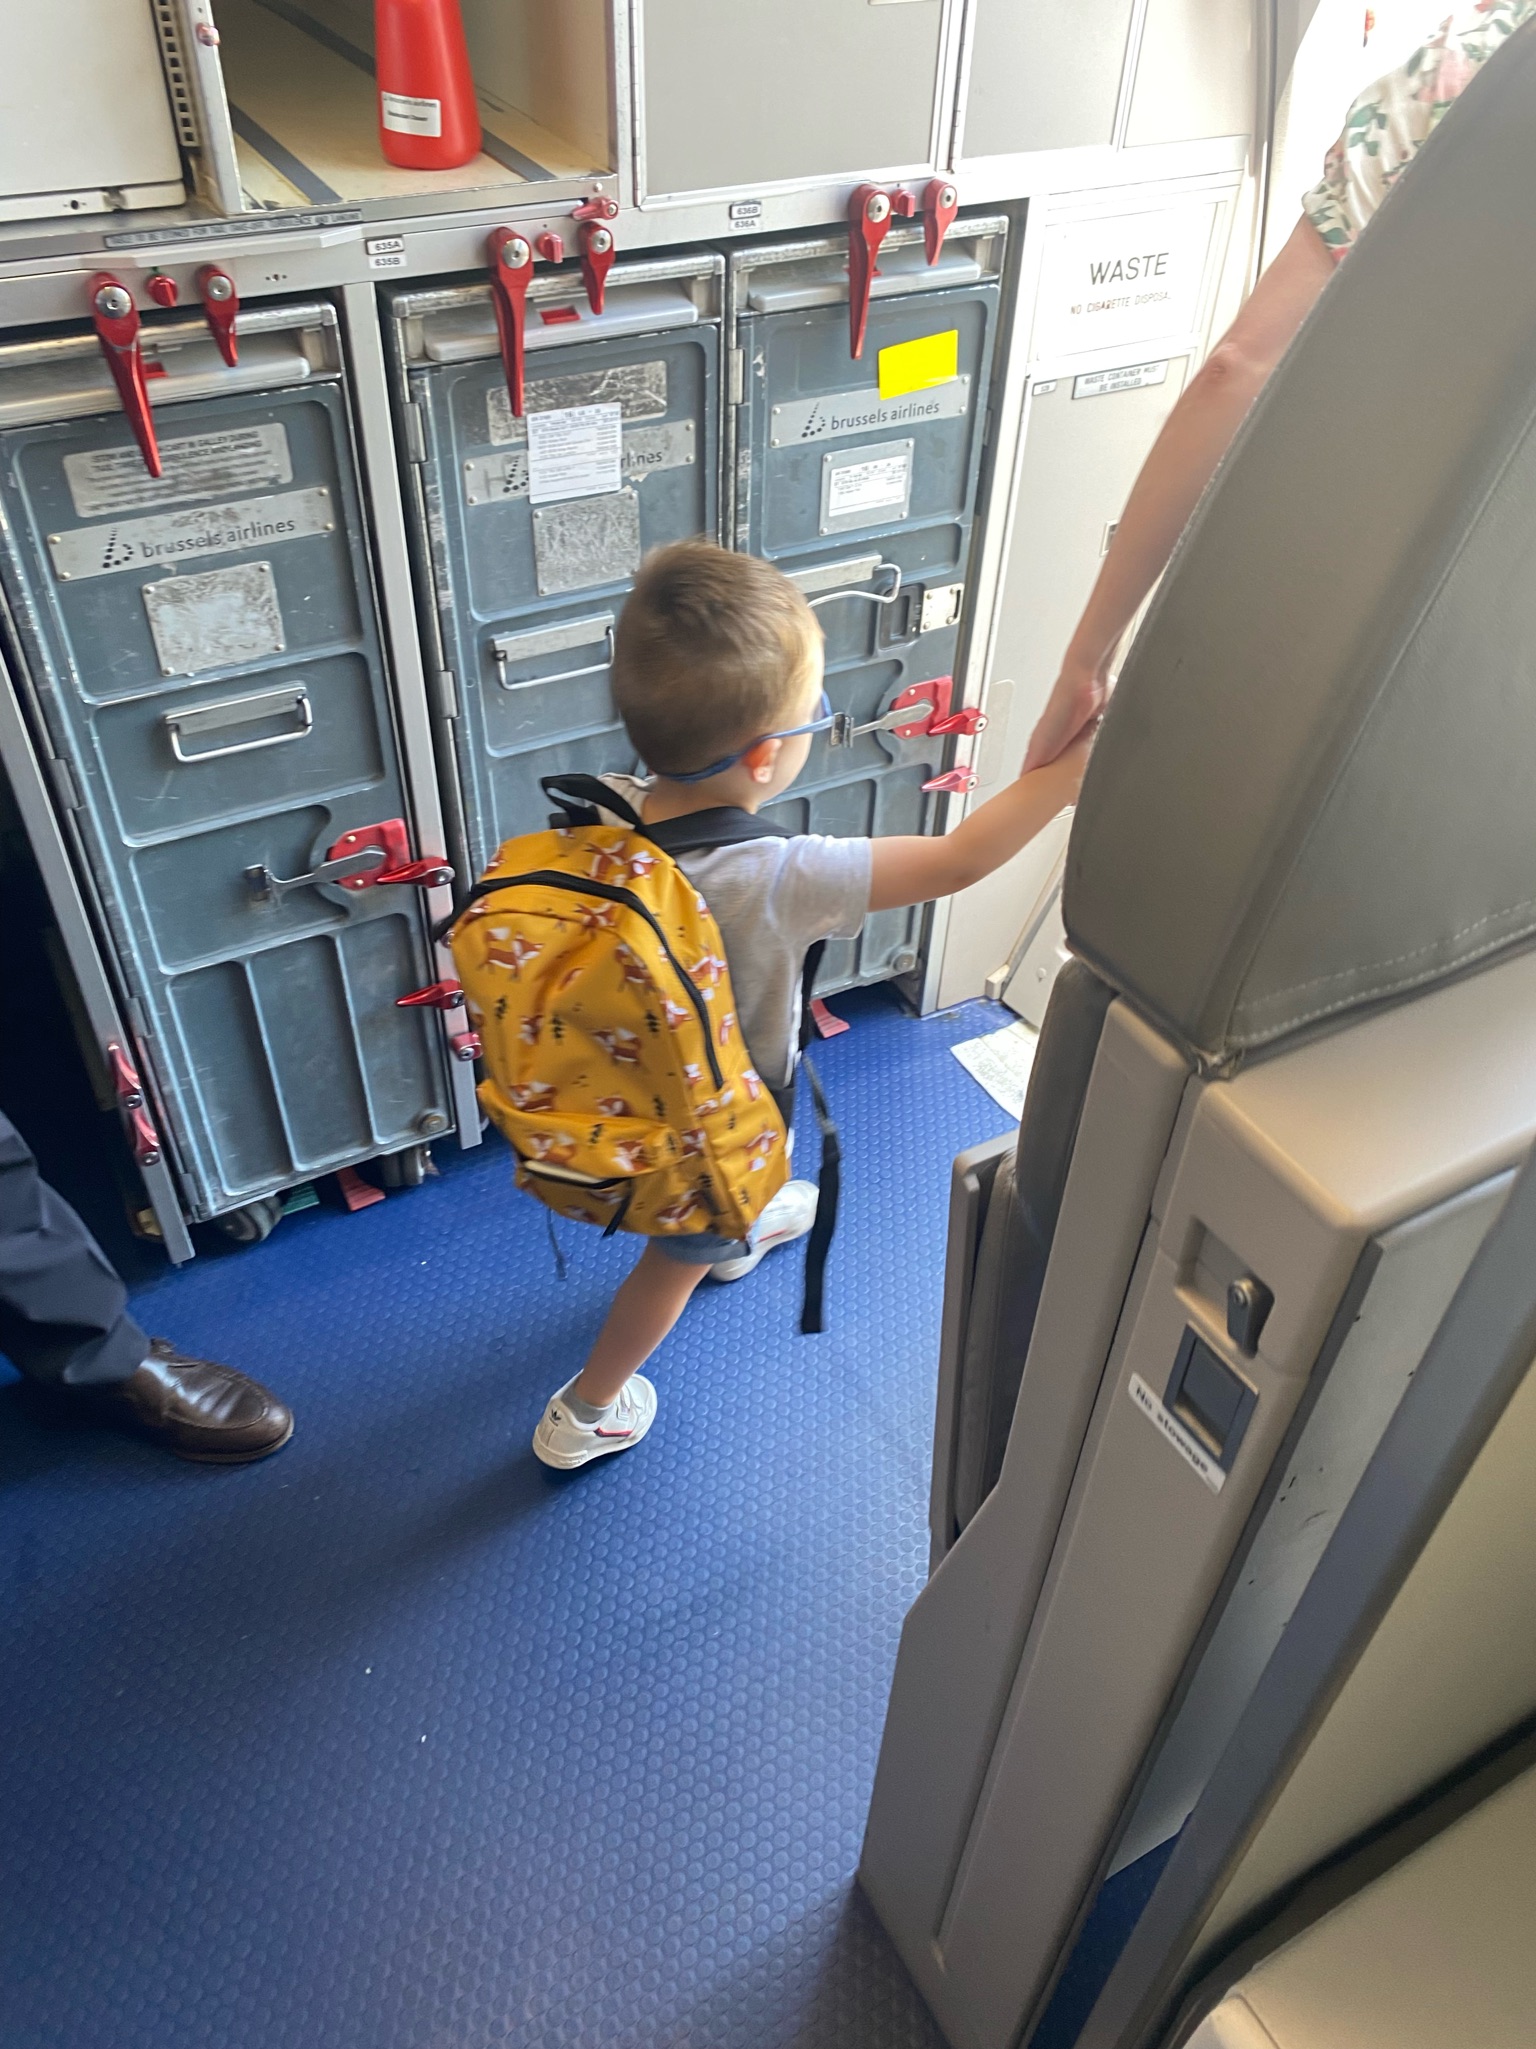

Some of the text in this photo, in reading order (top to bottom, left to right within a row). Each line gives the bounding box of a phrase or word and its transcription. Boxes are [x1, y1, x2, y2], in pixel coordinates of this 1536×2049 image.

[375, 240, 400, 250] 635A
[375, 257, 400, 266] 635B
[1090, 252, 1169, 285] WASTE
[1070, 304, 1082, 314] NO
[1086, 297, 1131, 313] CIGARETTE
[1084, 373, 1105, 385] WASTE
[1107, 368, 1142, 382] CONTAINER
[1109, 377, 1142, 390] INSTALLED
[831, 402, 940, 430] brussels airlines
[620, 451, 663, 469] rlines
[141, 519, 295, 558] brussels airlines
[1136, 1386, 1209, 1473] No stowage
